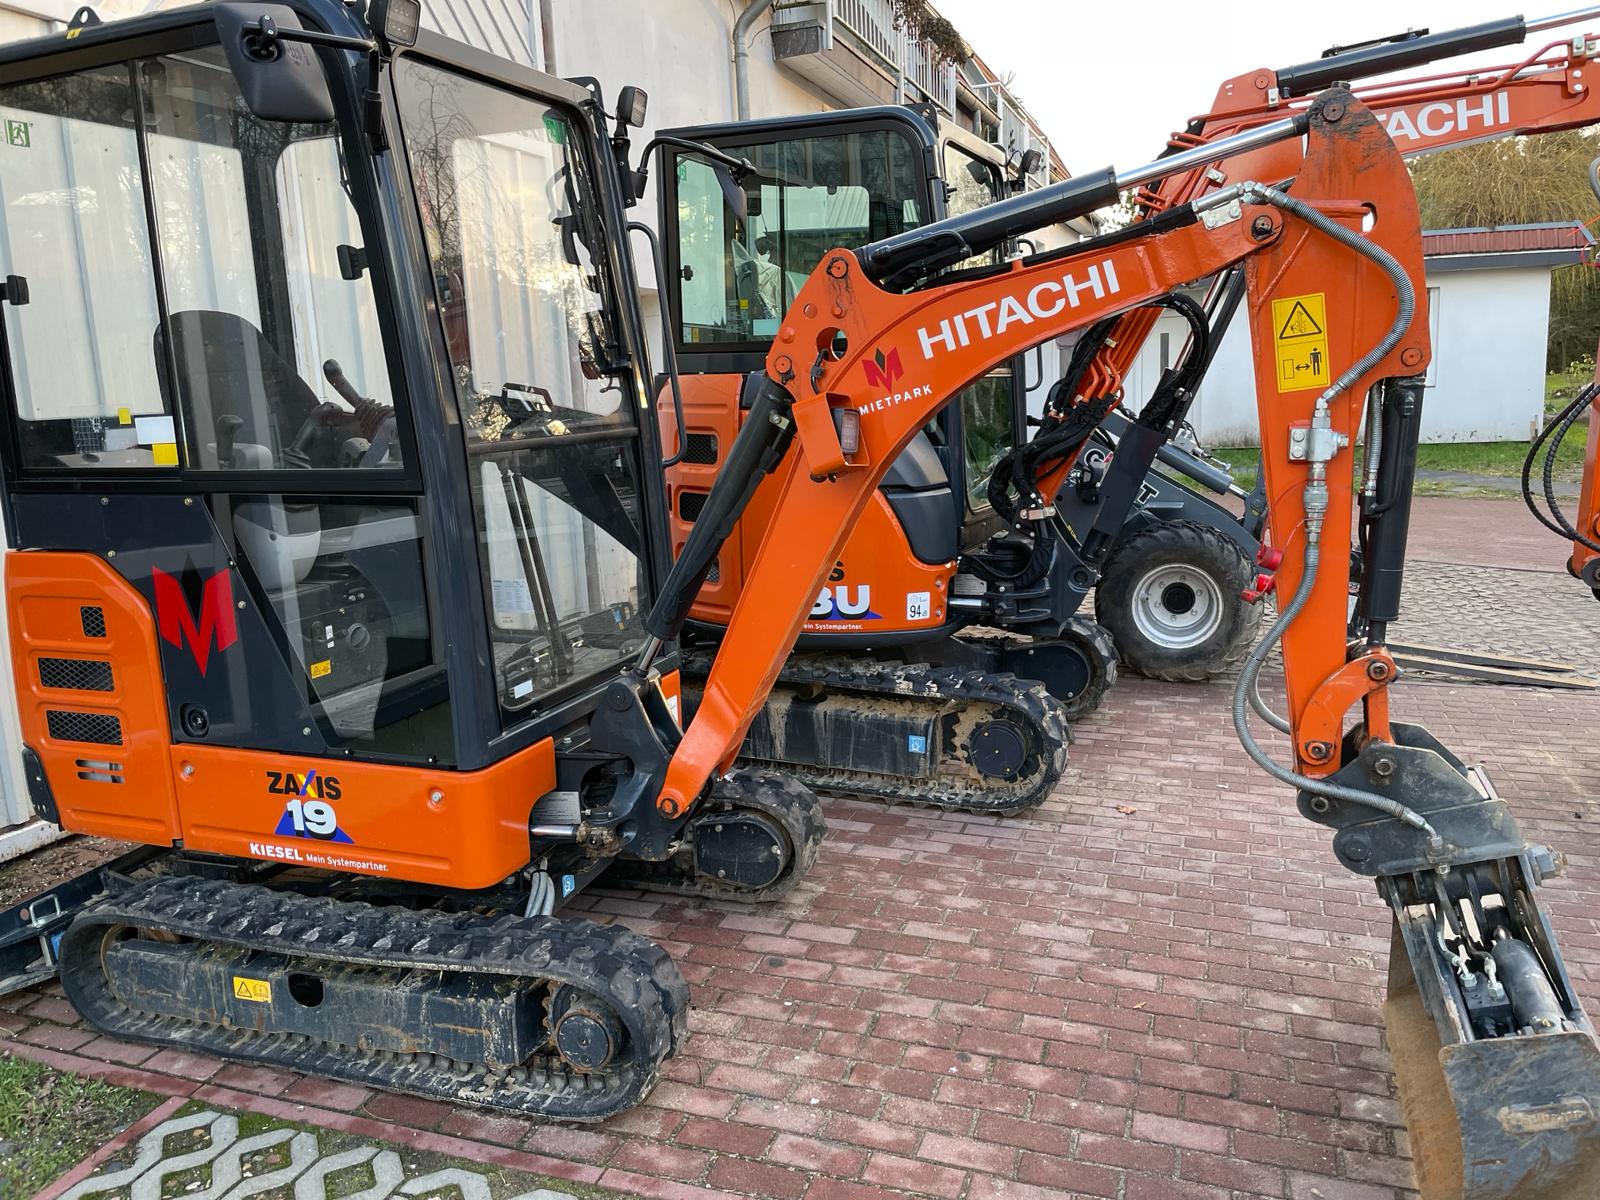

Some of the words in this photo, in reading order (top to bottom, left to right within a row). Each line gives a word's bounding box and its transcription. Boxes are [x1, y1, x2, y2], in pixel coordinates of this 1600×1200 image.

[917, 259, 1121, 360] HITACHI
[859, 384, 933, 416] MIETPARK
[909, 604, 922, 618] 94
[266, 769, 342, 800] ZAXIS
[286, 799, 338, 841] 19
[250, 843, 303, 861] KIESEL
[306, 853, 326, 864] Mein
[327, 856, 389, 872] Systempartner.
